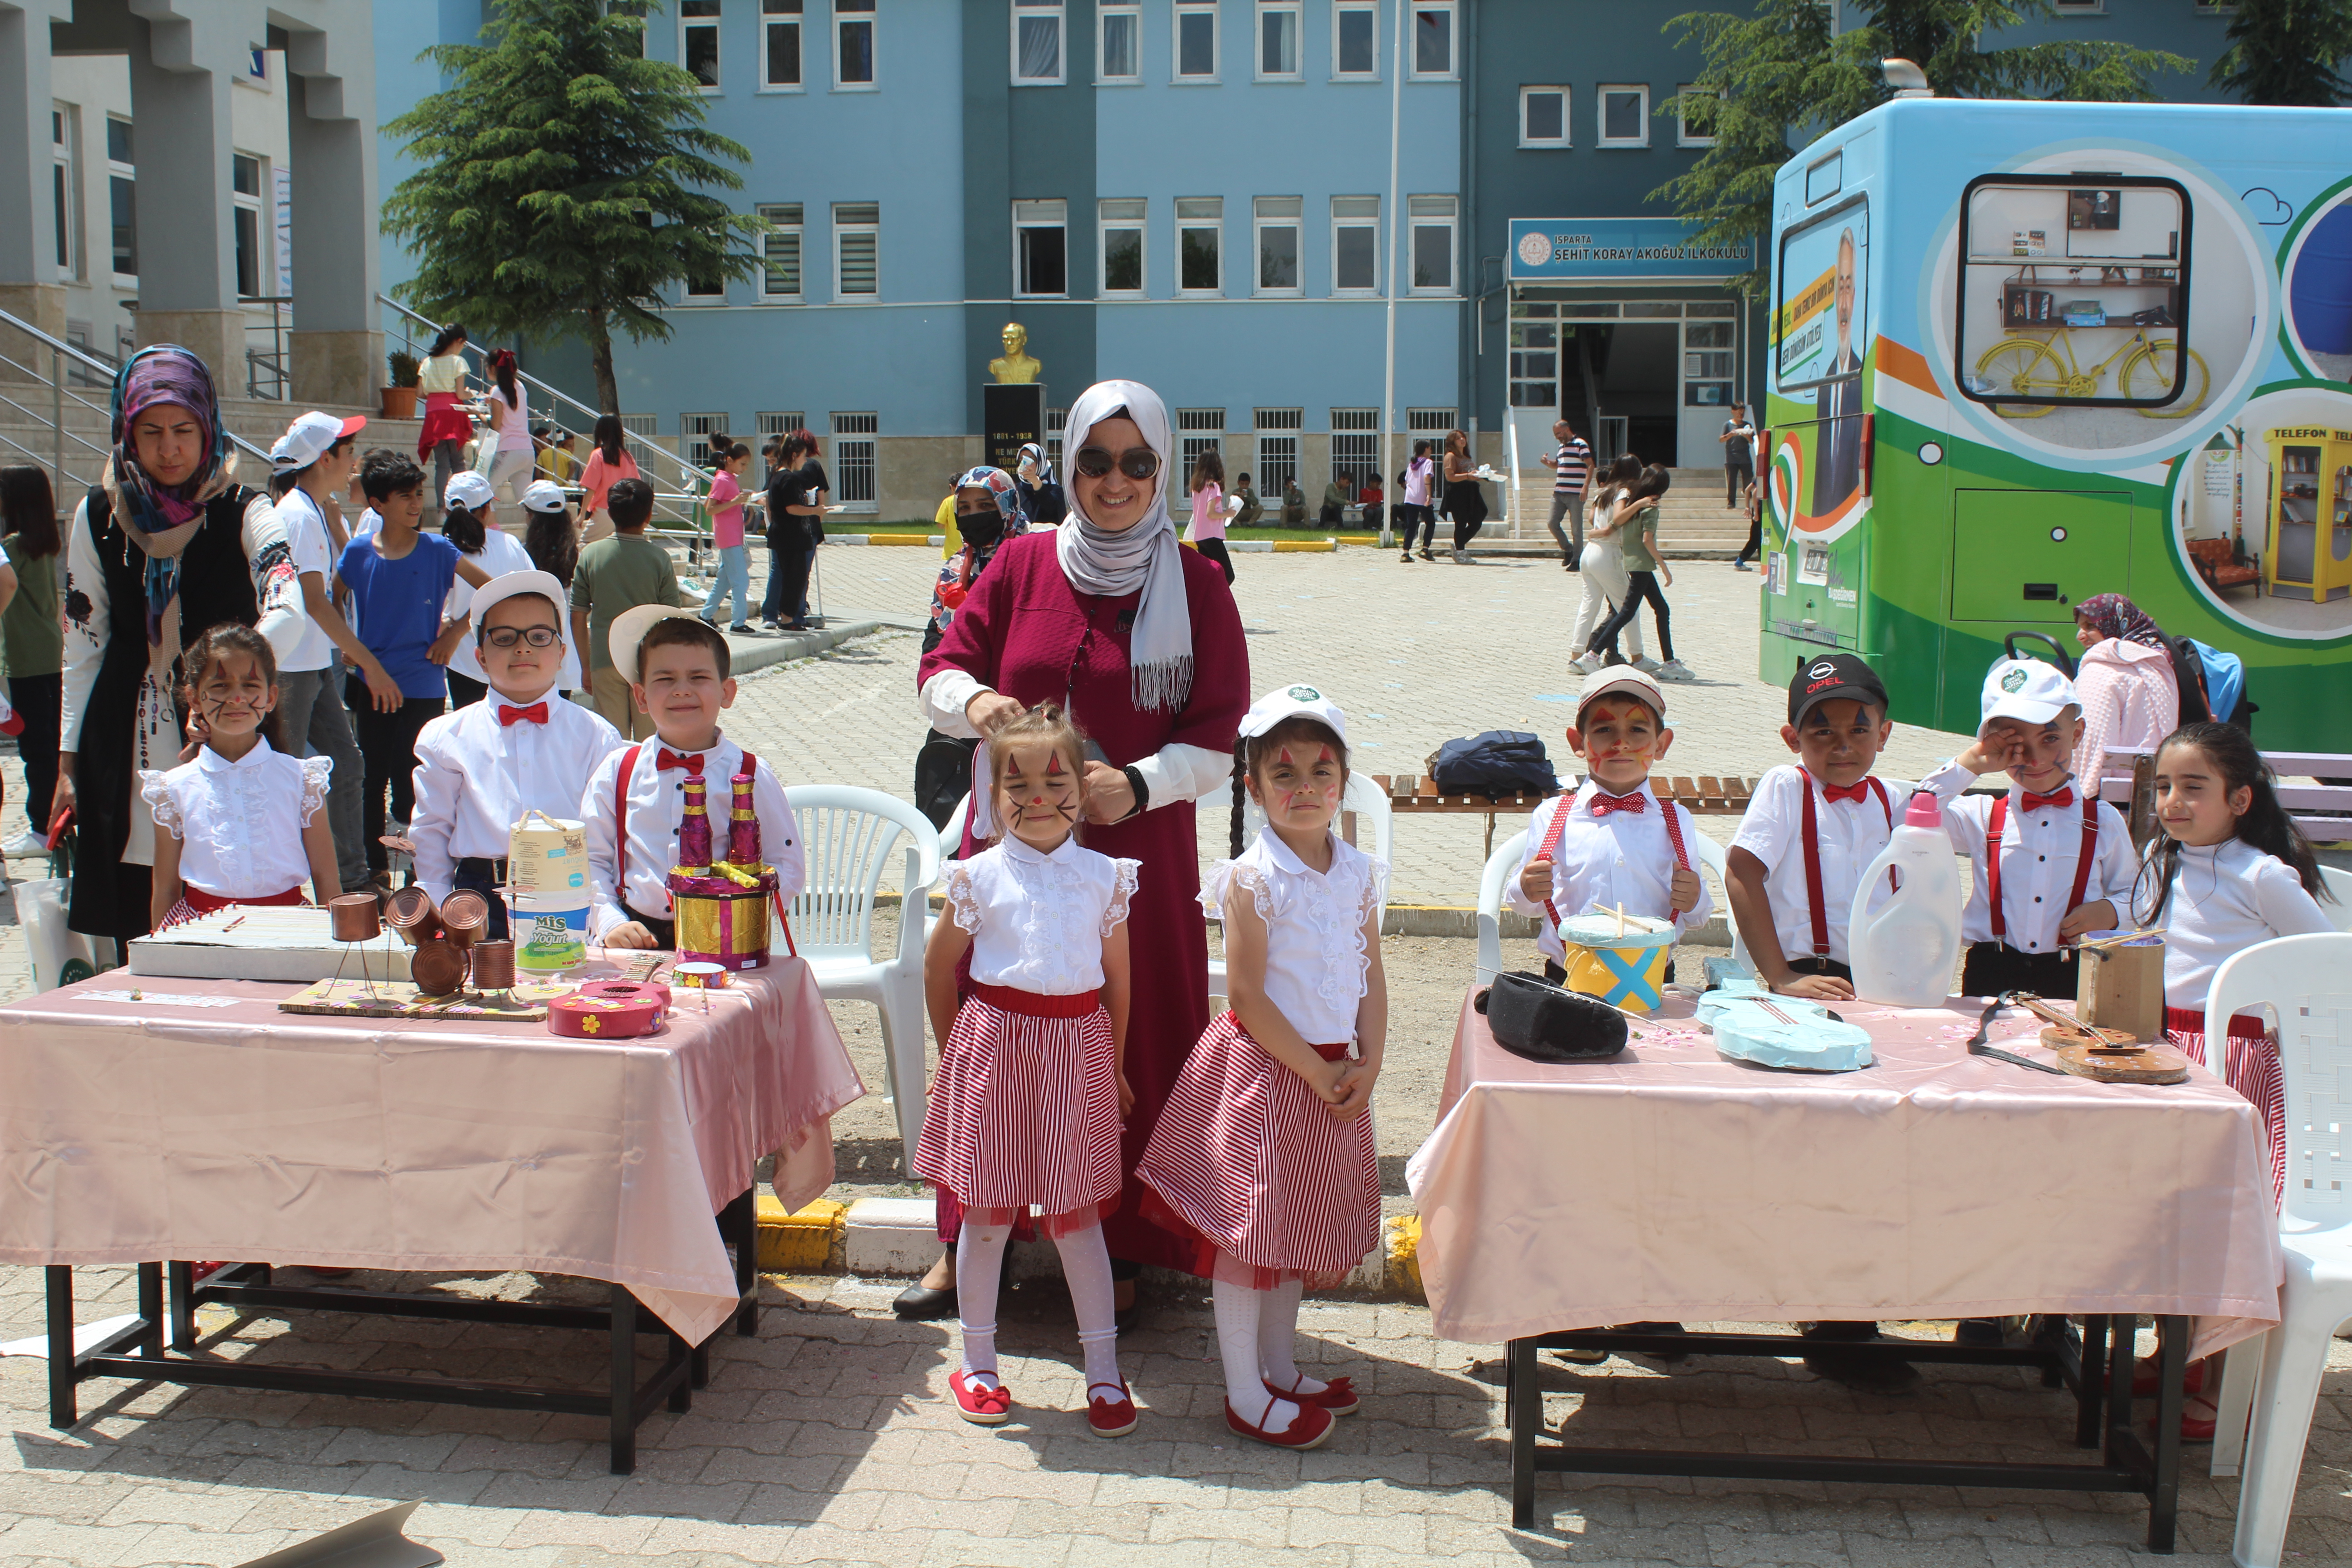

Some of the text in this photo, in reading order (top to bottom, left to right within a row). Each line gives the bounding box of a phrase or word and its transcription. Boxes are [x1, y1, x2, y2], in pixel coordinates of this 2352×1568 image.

[1554, 235, 1592, 244] ISPARTA
[1554, 245, 1748, 264] ŞEHİT KORAY AKOĞUZ İLKOKULU
[2274, 429, 2327, 438] TELEFON
[2335, 431, 2352, 441] TEL
[2004, 672, 2023, 684] TÜRKİYE
[1806, 676, 1845, 694] OPEL
[2004, 680, 2024, 690] HAFTASI
[533, 932, 568, 946] Yoğurt
[569, 995, 626, 1009] YAREN
